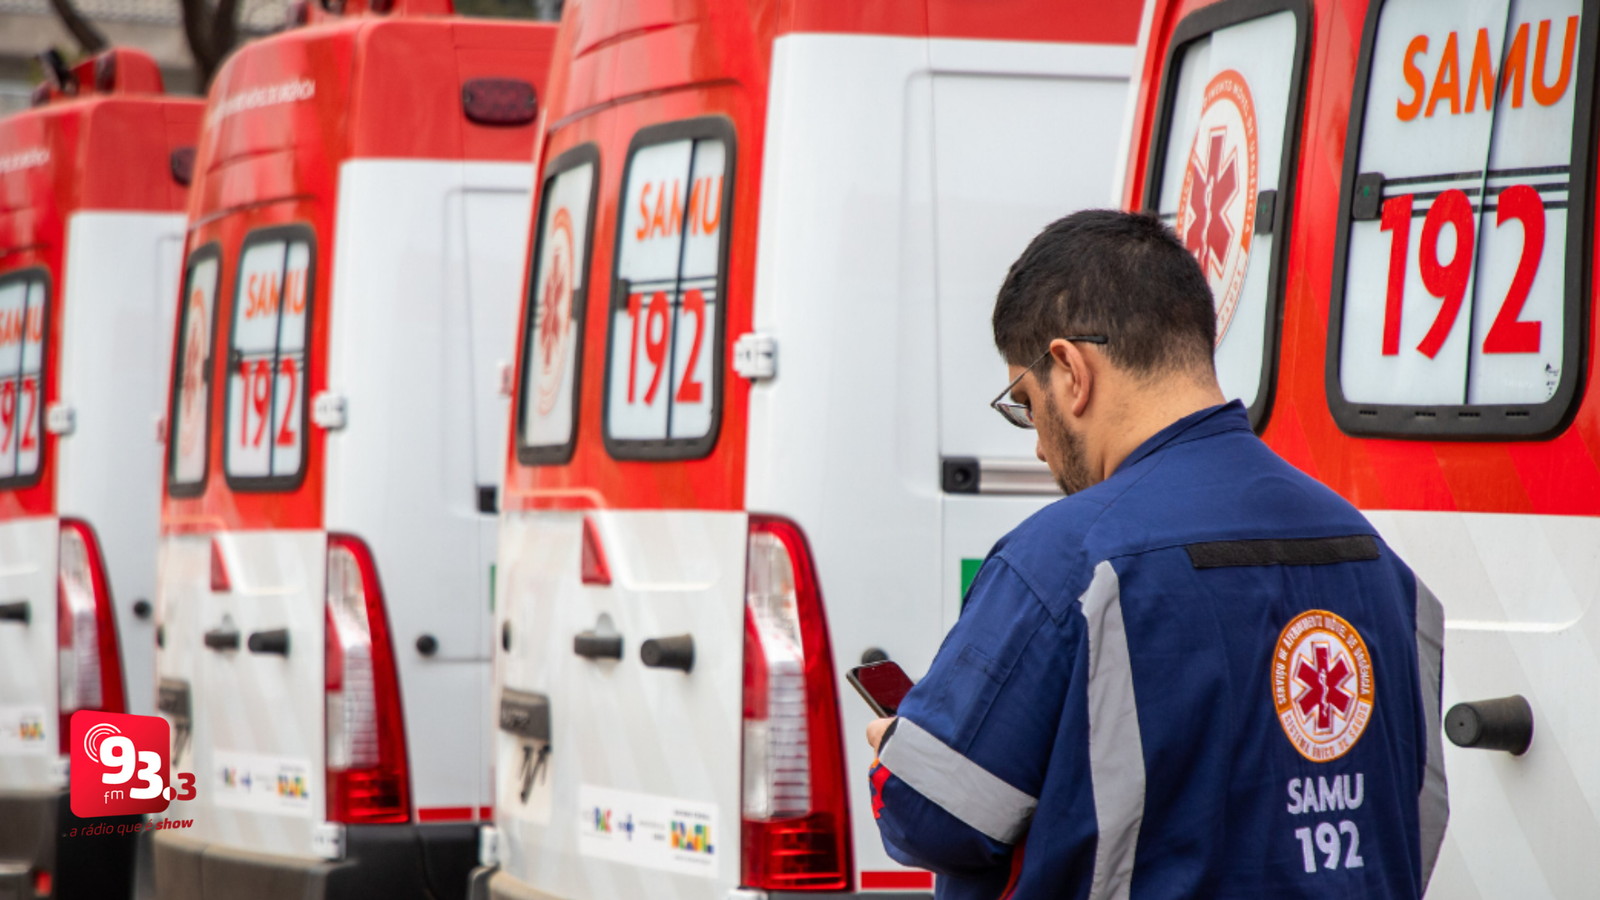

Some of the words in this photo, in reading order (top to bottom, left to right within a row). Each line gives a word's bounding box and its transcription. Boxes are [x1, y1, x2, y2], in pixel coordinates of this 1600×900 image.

[1396, 15, 1579, 122] SAMU
[636, 174, 724, 242] SAMU
[245, 268, 309, 320] SAMU
[1380, 184, 1546, 360] 192
[627, 287, 706, 406] 192
[0, 376, 37, 454] 92
[240, 354, 297, 448] 192
[1286, 773, 1364, 815] SAMU
[1294, 820, 1364, 873] 192
